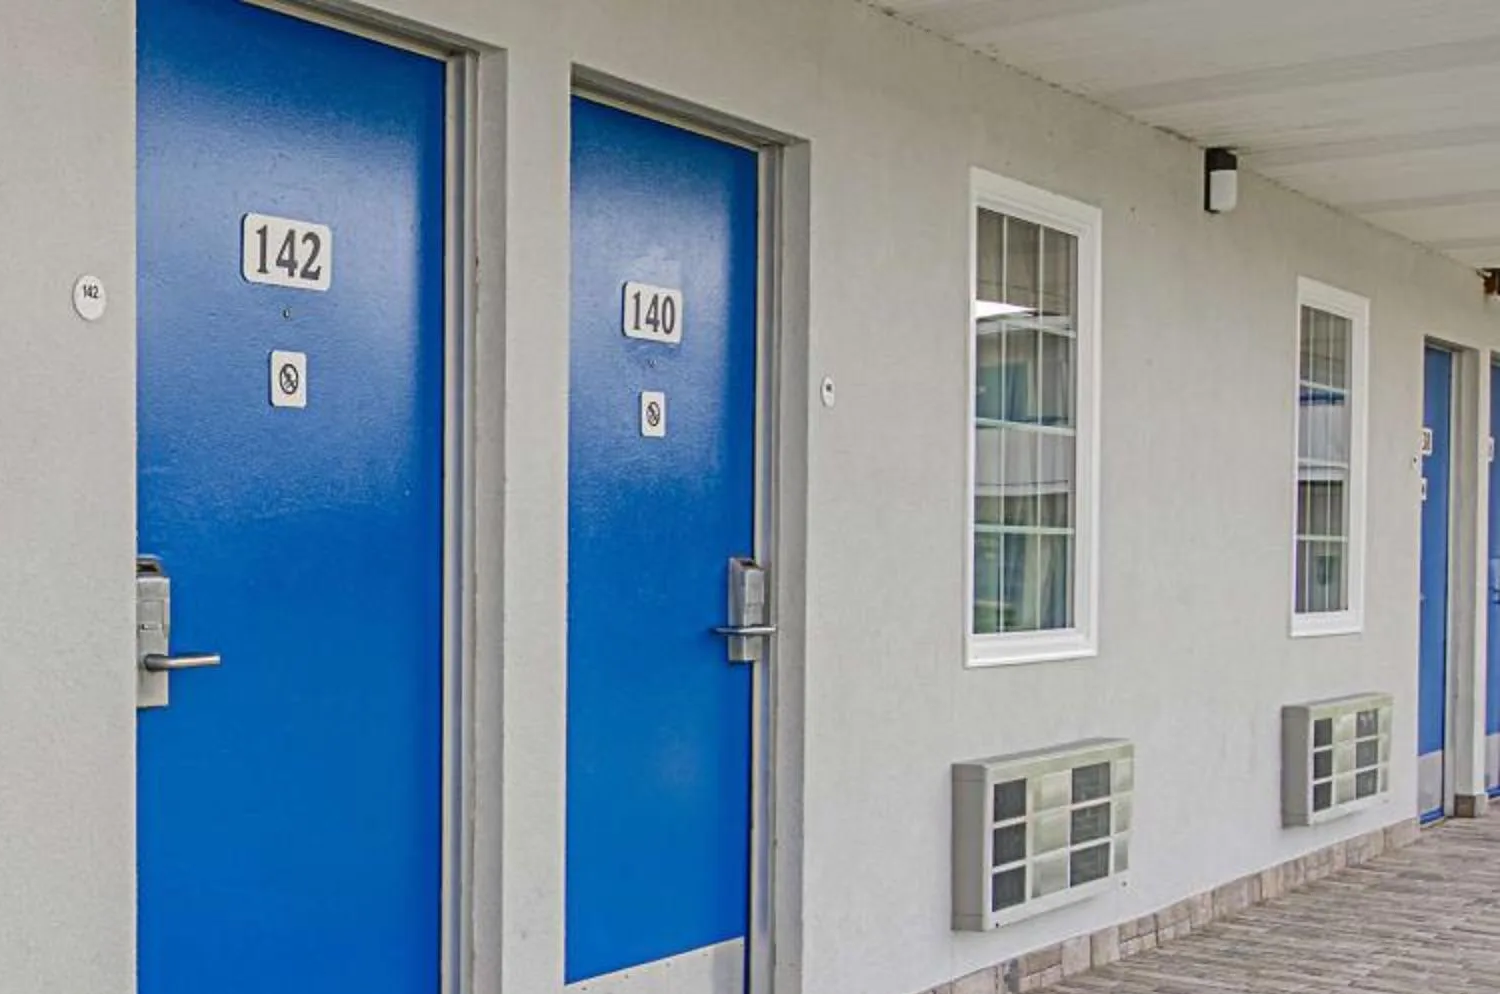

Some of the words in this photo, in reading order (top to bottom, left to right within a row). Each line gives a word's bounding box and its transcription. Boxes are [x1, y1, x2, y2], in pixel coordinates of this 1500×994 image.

[256, 224, 321, 280] 142
[83, 284, 99, 299] 142
[632, 290, 675, 334] 140
